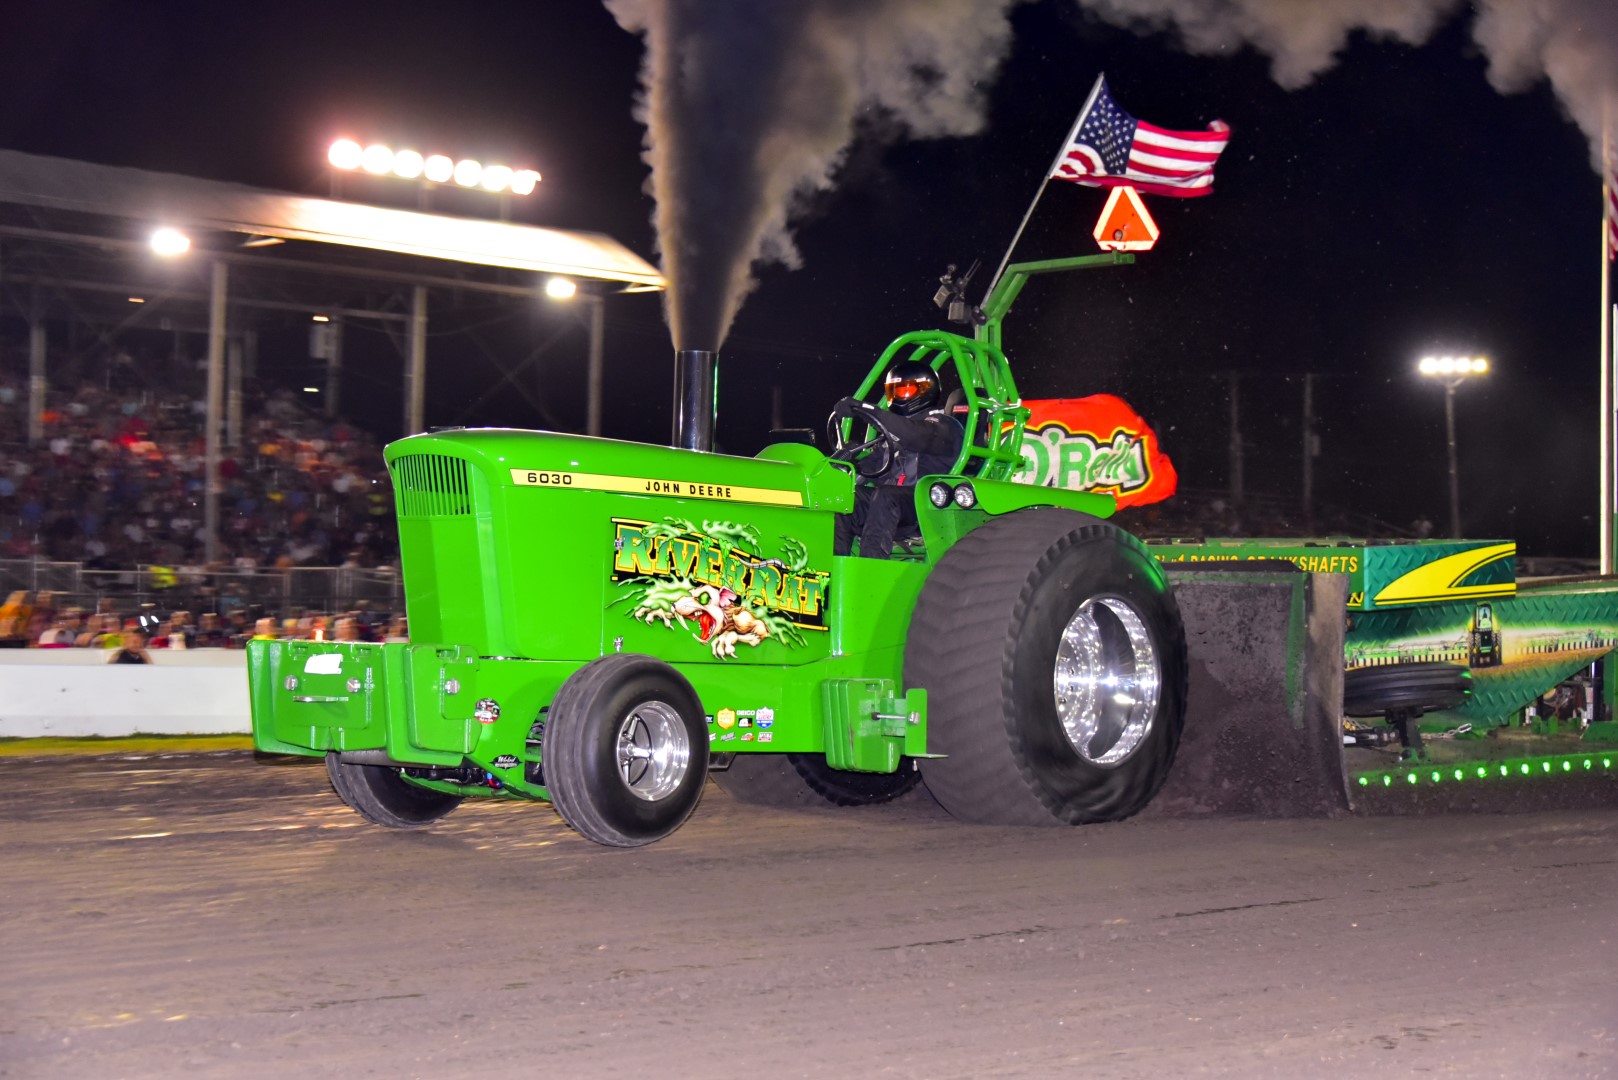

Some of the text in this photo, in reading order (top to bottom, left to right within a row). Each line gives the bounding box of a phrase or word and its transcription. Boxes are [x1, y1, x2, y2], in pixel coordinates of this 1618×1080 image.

[527, 472, 572, 485] 6030
[645, 481, 732, 498] JOHN DEERE
